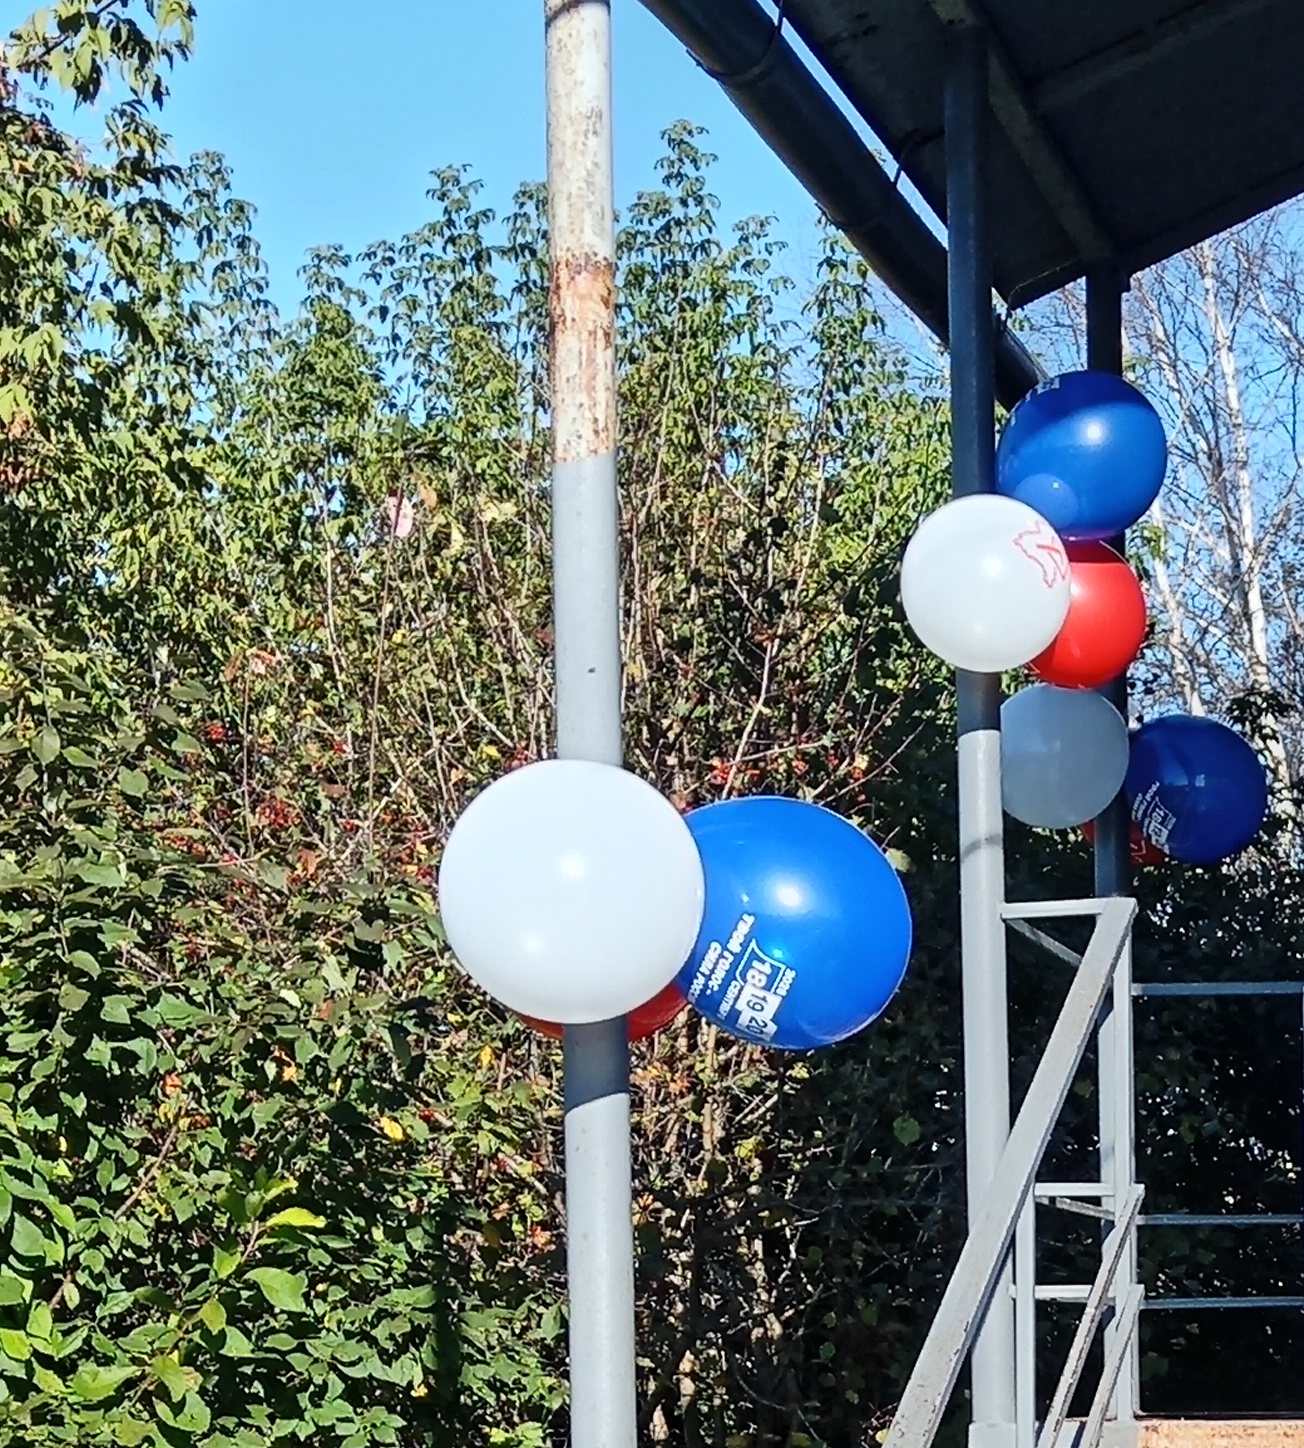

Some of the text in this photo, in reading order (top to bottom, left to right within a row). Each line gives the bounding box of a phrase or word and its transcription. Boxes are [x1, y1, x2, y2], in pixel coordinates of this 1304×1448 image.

[727, 913, 755, 954] ТВОЙ
[699, 941, 722, 976] СИЛА
[708, 950, 735, 992] ГОЛОС
[746, 959, 772, 988] 18
[746, 993, 769, 1013] 19
